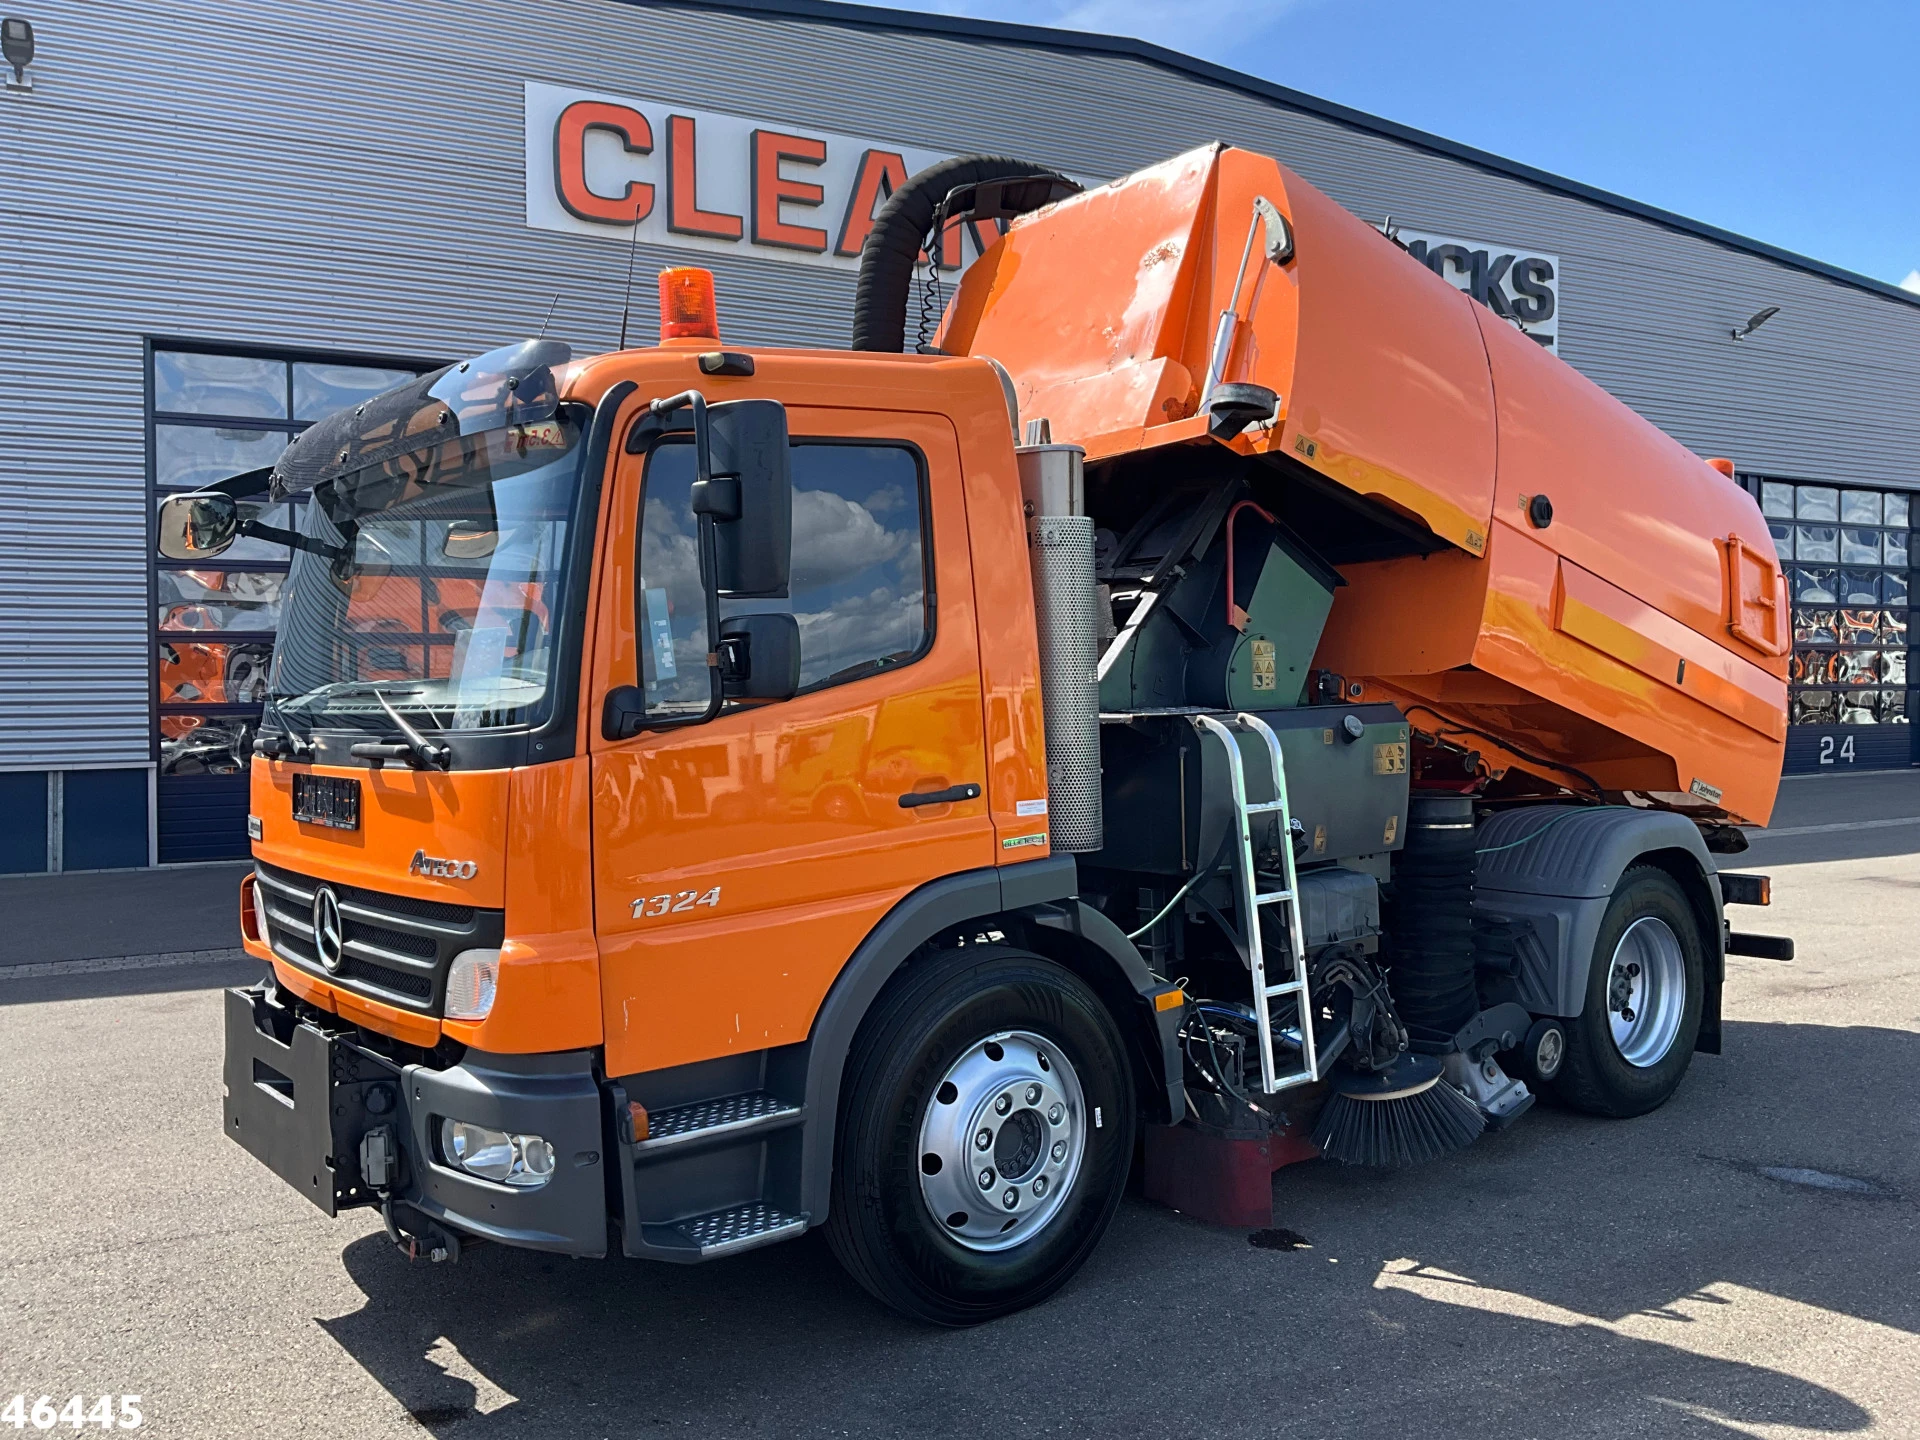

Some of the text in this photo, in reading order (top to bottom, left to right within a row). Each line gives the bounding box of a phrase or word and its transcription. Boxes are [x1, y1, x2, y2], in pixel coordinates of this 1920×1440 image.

[1408, 239, 1555, 323] CKS
[1820, 735, 1856, 764] 24
[630, 886, 721, 919] 1324
